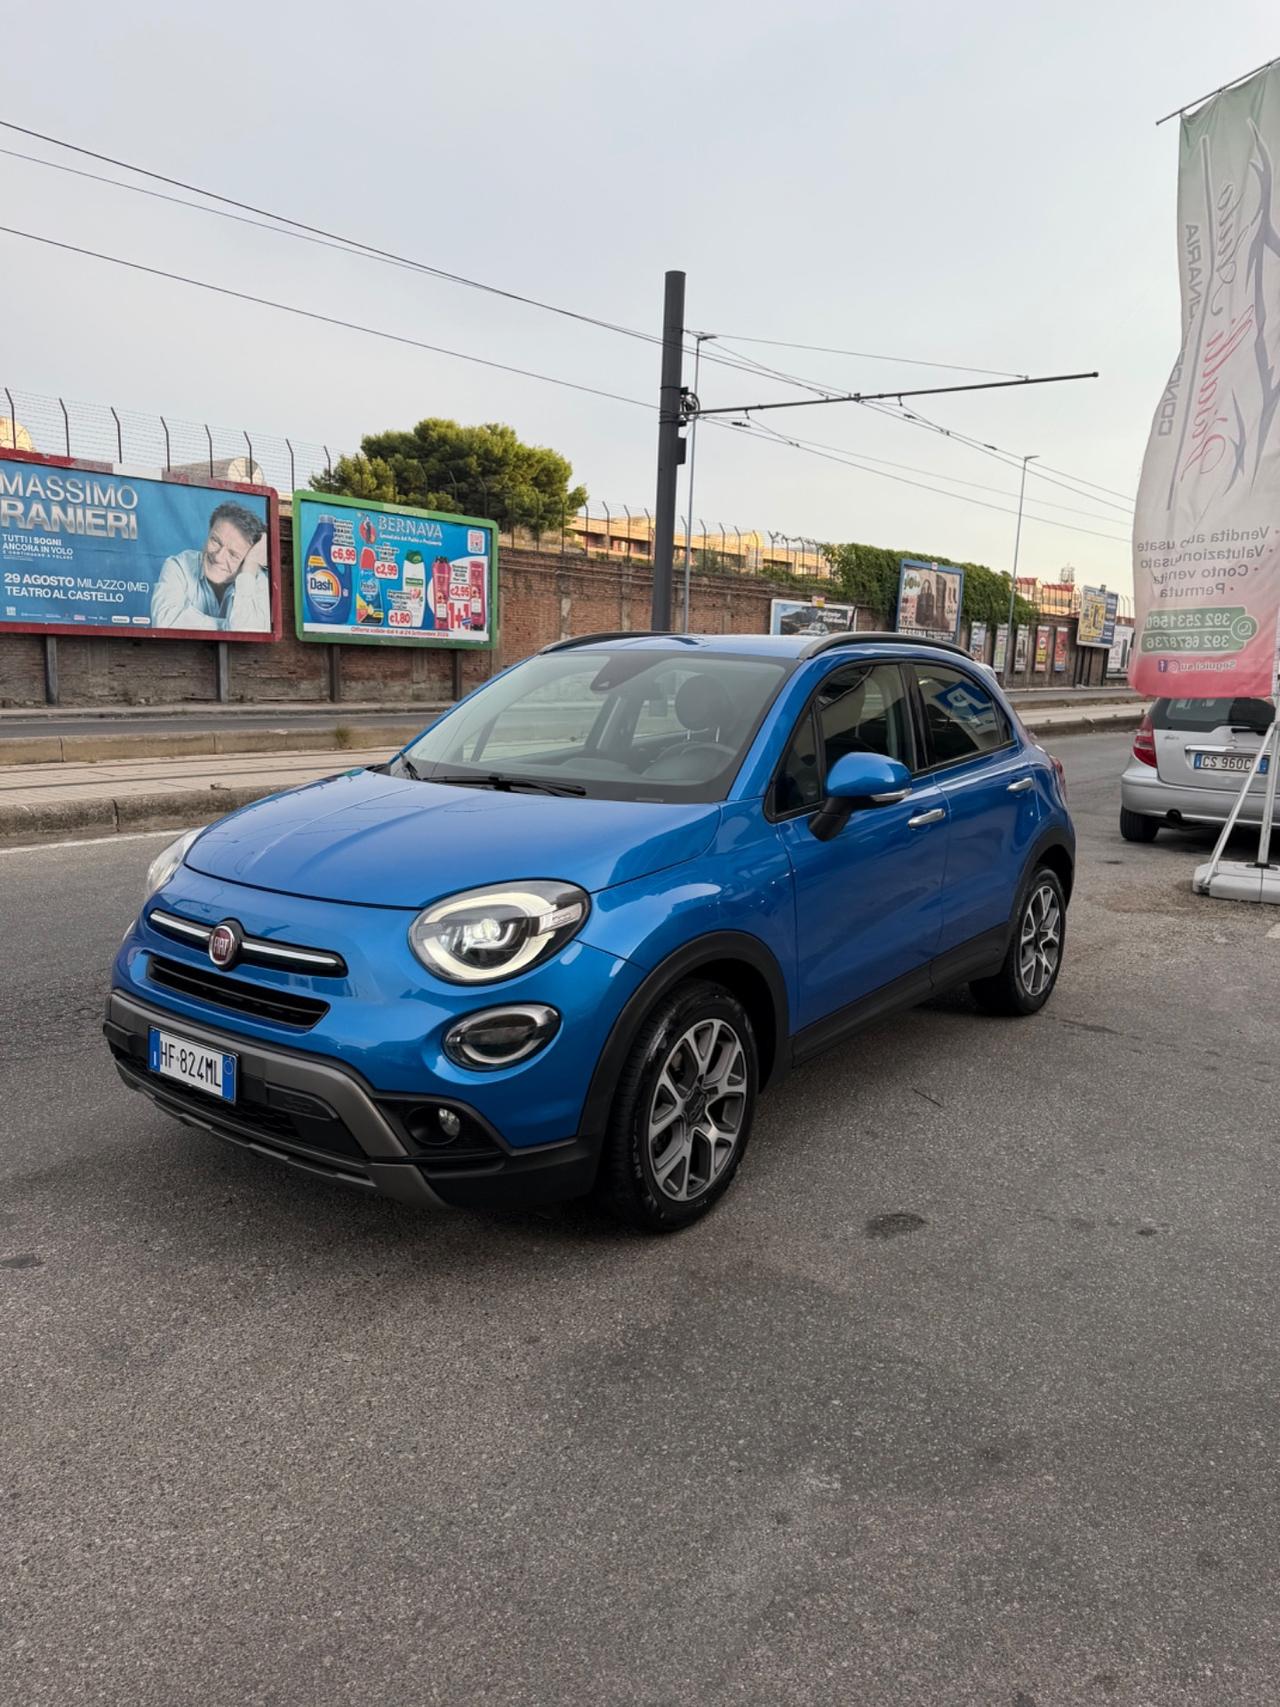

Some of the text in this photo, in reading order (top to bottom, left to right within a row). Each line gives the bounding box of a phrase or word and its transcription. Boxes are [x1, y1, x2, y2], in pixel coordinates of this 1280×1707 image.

[0, 469, 138, 510] MASSIMO
[0, 497, 138, 540] RANIERI
[378, 515, 443, 539] BERNAVA
[2, 533, 28, 544] TUTTI
[33, 536, 62, 546] SOGNI
[2, 542, 39, 553] ANCORA
[40, 545, 50, 553] IN
[51, 546, 74, 556] VOLO
[4, 572, 150, 594] 29 AGOSTO MILAZZO (ME)
[310, 577, 334, 592] Dash
[4, 586, 125, 603] TEATRO AL CASTELLO
[1202, 755, 1255, 770] CS 960C
[214, 935, 230, 957] FIAT
[160, 1040, 176, 1069] HF
[180, 1048, 222, 1088] 824ML
